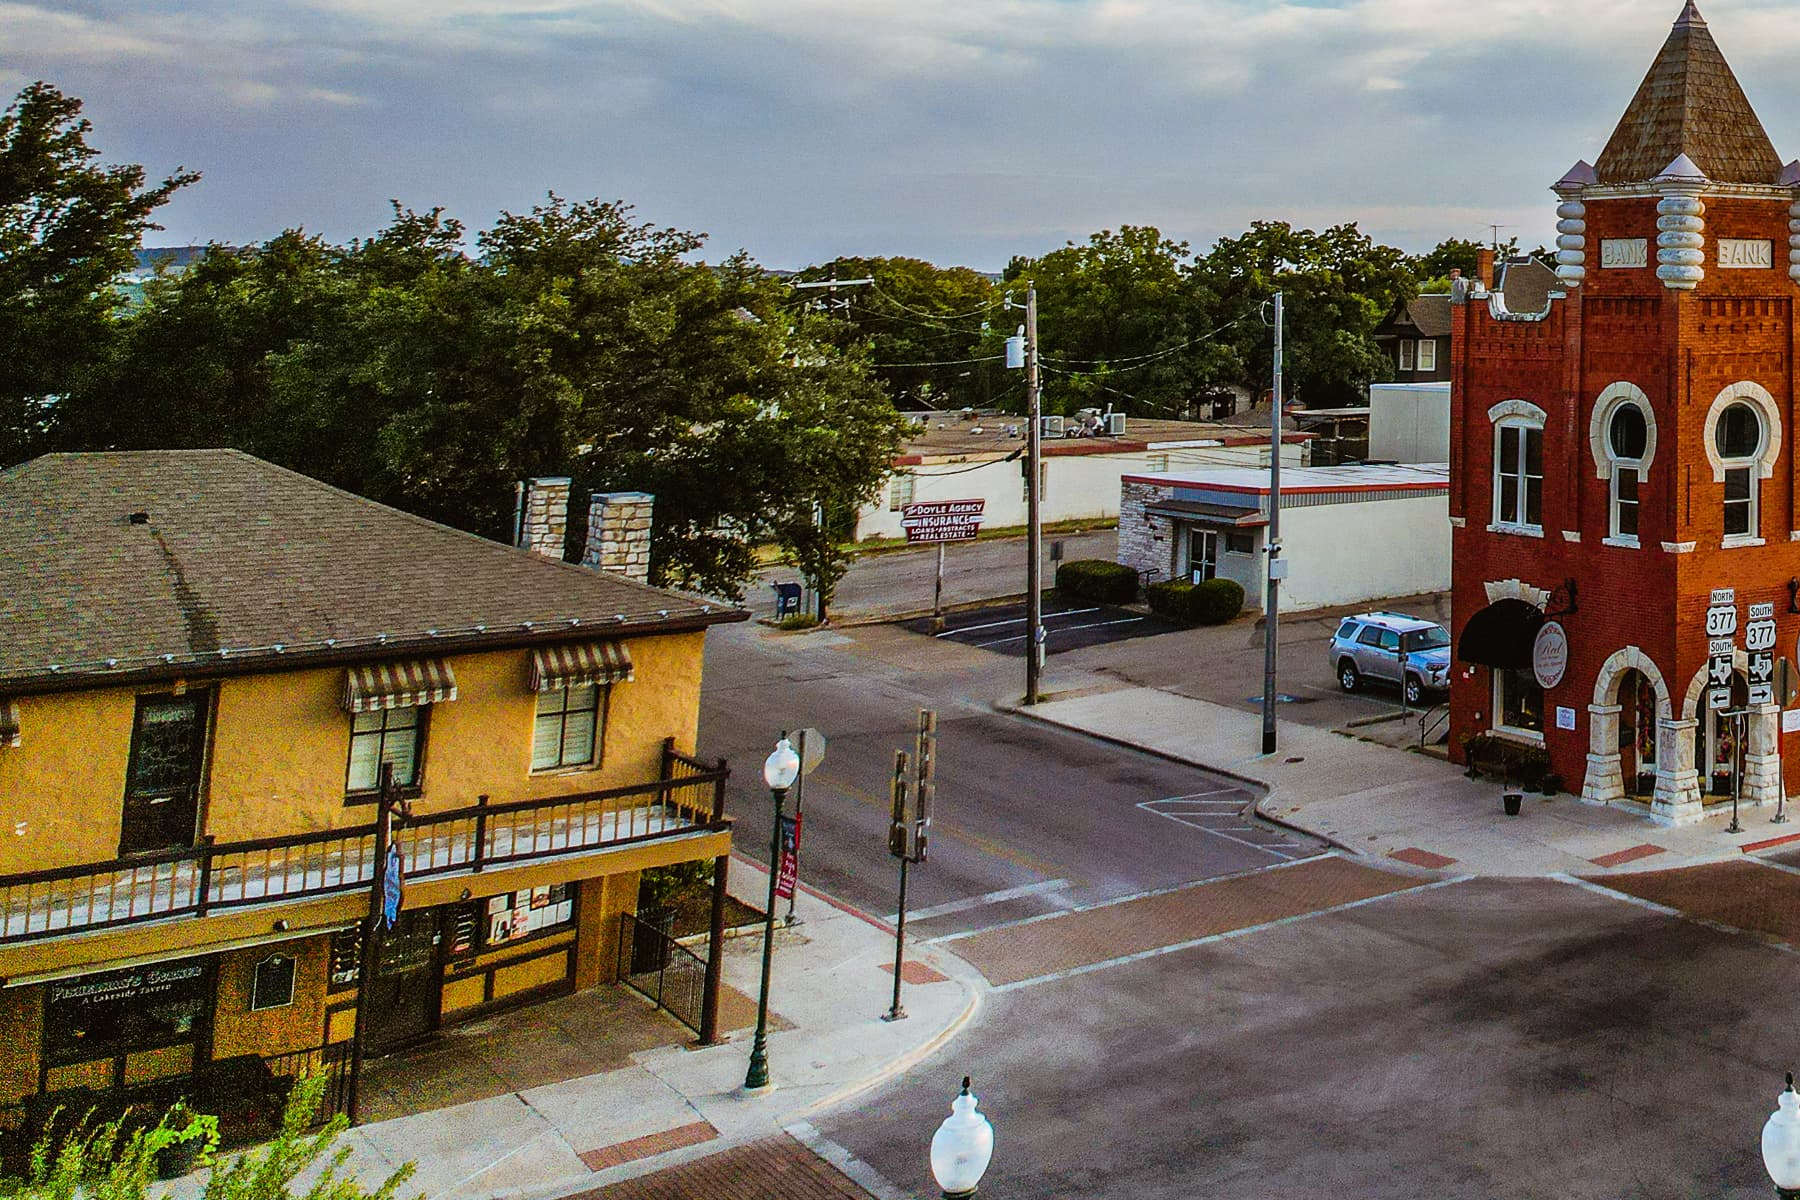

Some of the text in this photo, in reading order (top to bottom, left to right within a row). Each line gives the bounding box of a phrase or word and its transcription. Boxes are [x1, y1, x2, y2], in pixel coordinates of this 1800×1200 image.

[1603, 240, 1647, 265] BANK
[1718, 241, 1770, 265] BANK
[917, 505, 946, 515] DOYLE
[949, 503, 983, 513] AGENCY
[918, 515, 969, 527] INSURANCE
[920, 531, 965, 540] REAL ESTATE
[1712, 592, 1733, 602] NORTH
[1751, 607, 1773, 617] SOUTH
[1710, 612, 1734, 630] 377
[1749, 626, 1773, 645] 377
[1710, 642, 1732, 652] SOUTH
[1720, 666, 1725, 674] 4
[1759, 661, 1768, 671] 51
